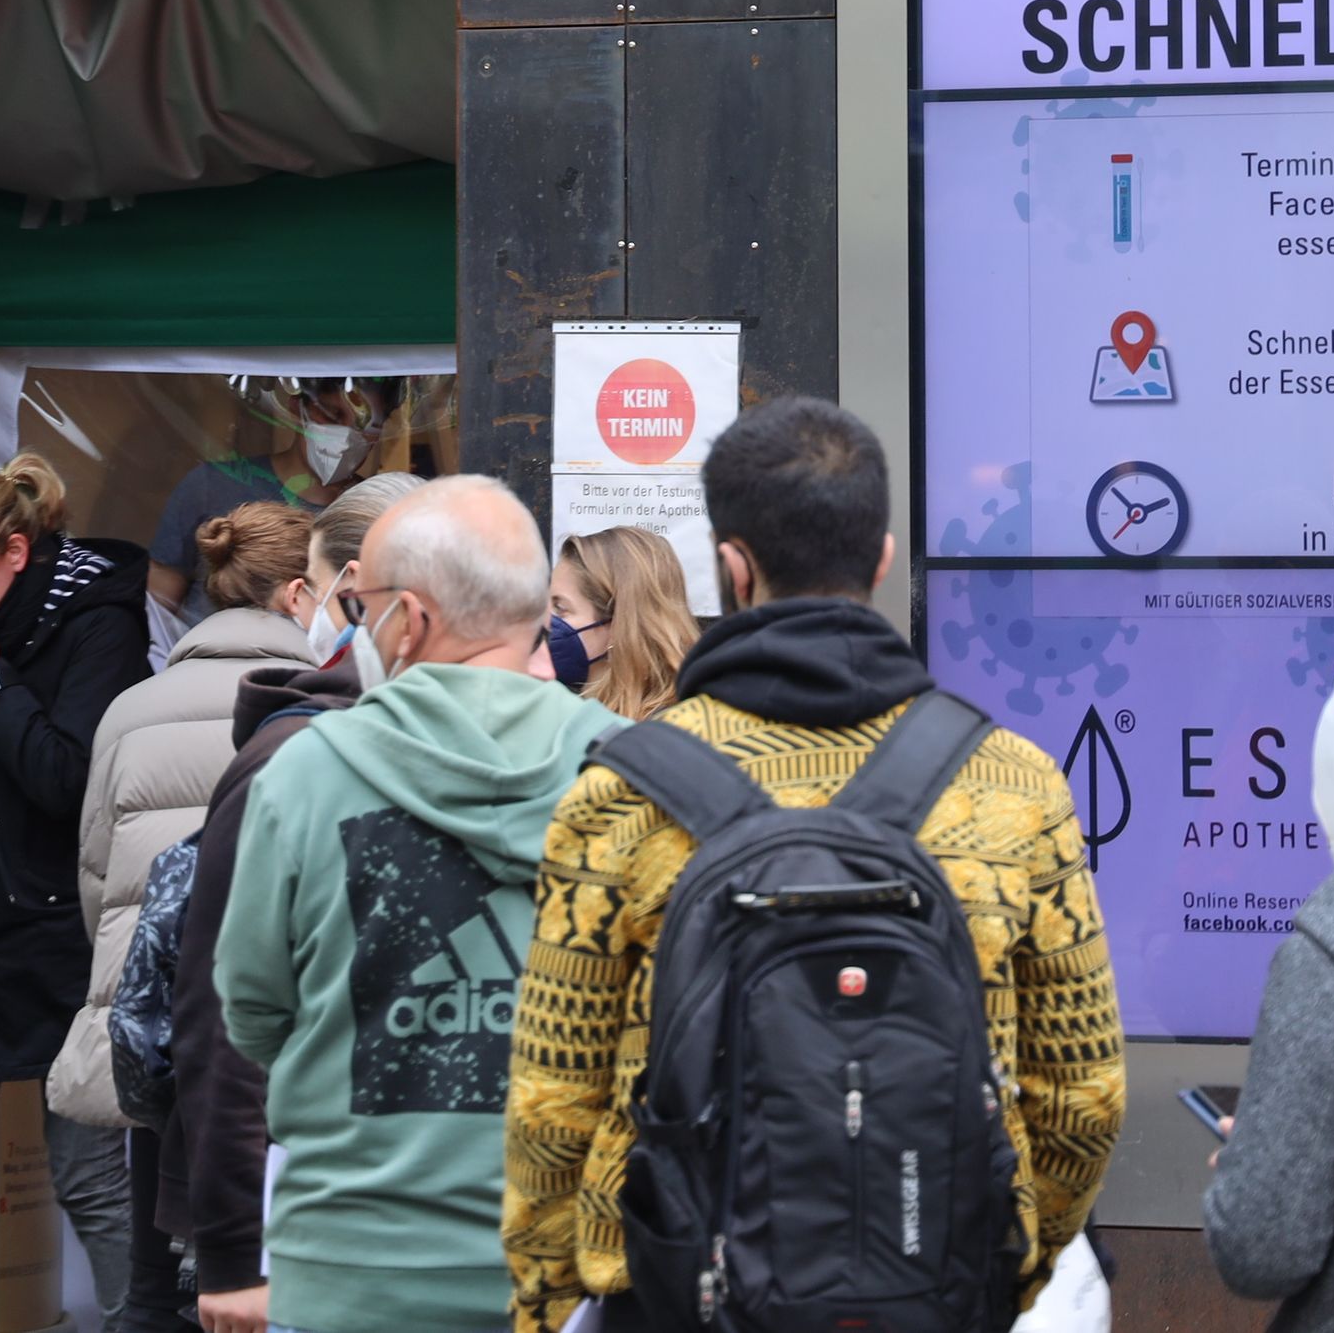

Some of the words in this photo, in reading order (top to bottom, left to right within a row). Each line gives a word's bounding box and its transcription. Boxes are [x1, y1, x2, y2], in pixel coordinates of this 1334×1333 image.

[1229, 370, 1270, 394] der
[623, 389, 668, 408] KEIN
[607, 418, 683, 437] TERMIN
[582, 483, 609, 496] Bitte
[611, 486, 630, 496] vor
[633, 485, 652, 497] der
[656, 484, 702, 499] Testung
[569, 502, 620, 515] Formular
[623, 503, 633, 514] in
[636, 503, 656, 515] der
[1303, 523, 1326, 551] in
[1144, 594, 1171, 608] MIT
[1175, 591, 1242, 608] GÜLTIGER
[1183, 891, 1238, 909] Online
[1244, 892, 1310, 910] Reserv
[900, 1149, 921, 1256] SWISSGEAR
